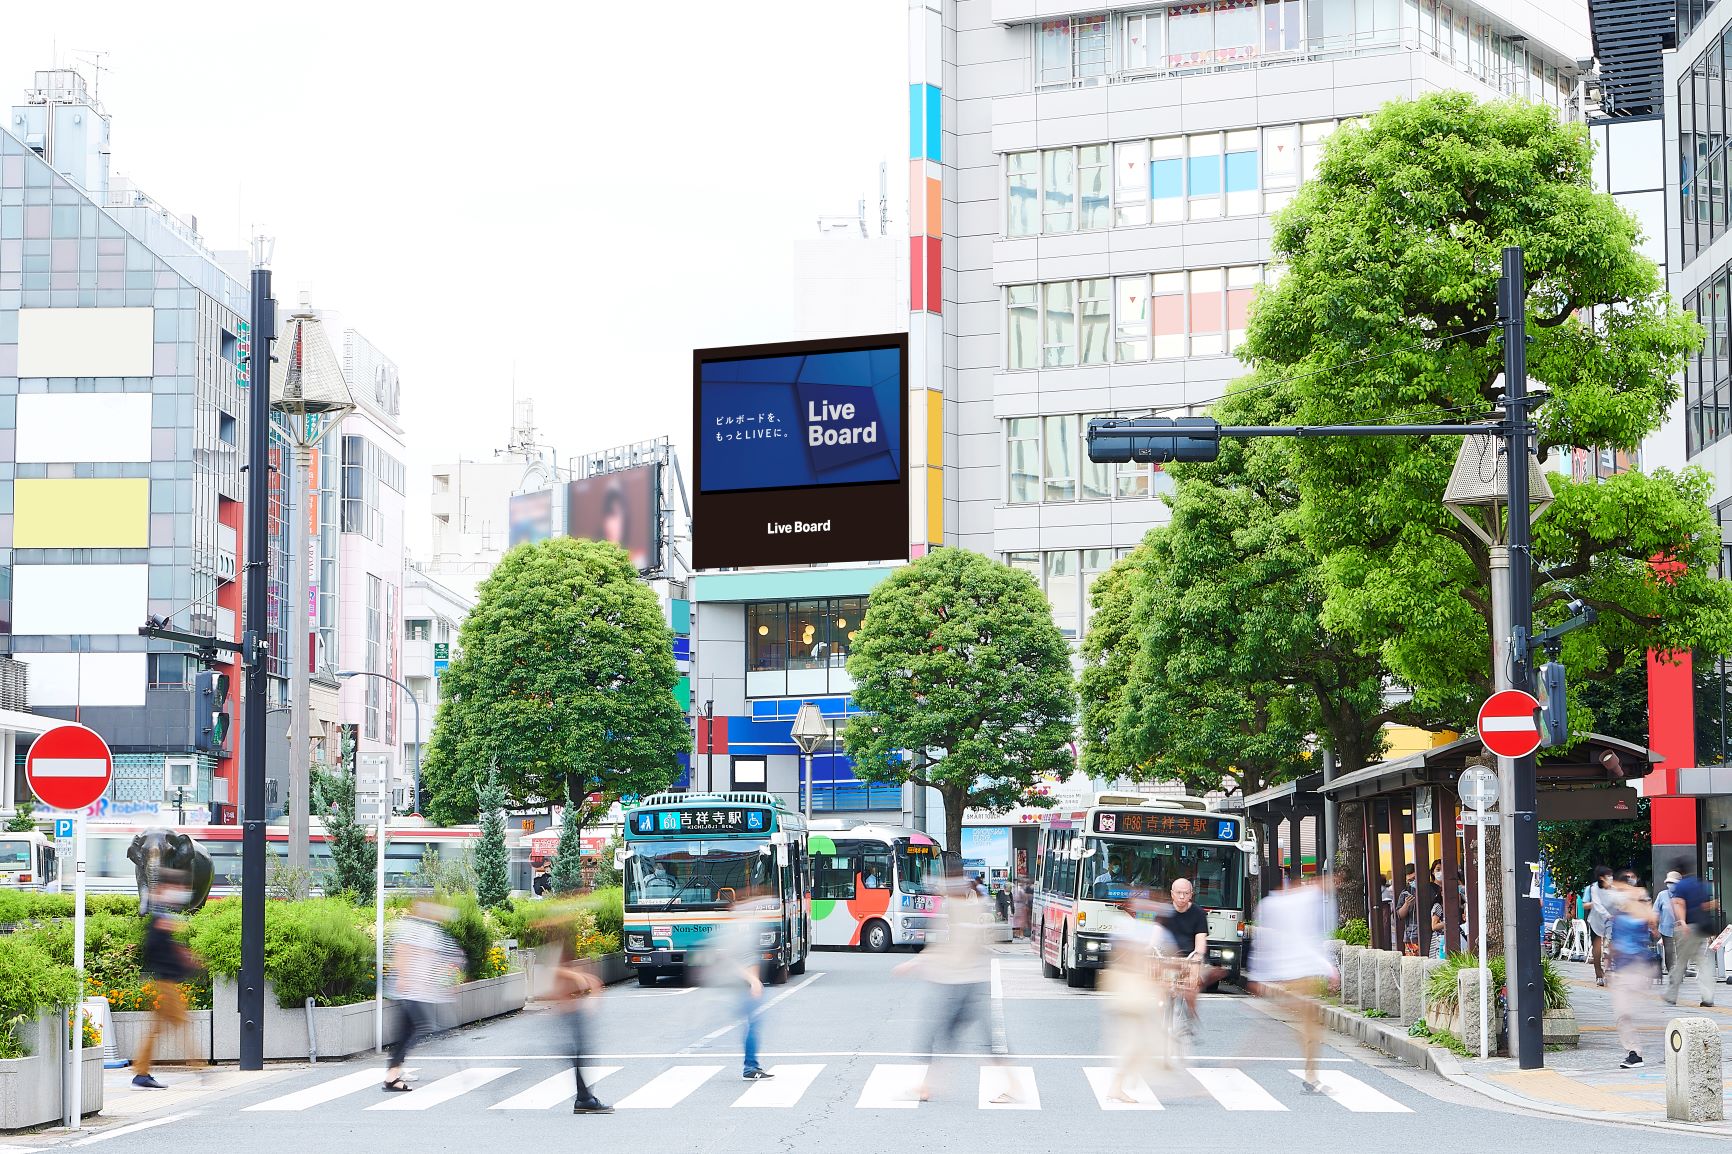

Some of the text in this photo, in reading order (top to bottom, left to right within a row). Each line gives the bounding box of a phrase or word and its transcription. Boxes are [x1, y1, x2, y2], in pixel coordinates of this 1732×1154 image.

[808, 400, 856, 422] Live
[715, 412, 782, 426] ビルボードを、
[715, 428, 789, 442] もっとLIVEに。
[808, 421, 877, 447] Board
[767, 519, 831, 535] Live Board
[663, 817, 677, 829] 60
[680, 811, 742, 826] 吉祥寺駅
[1146, 815, 1207, 832] 吉祥寺駅
[59, 821, 70, 836] P
[673, 925, 713, 934] Non-Step
